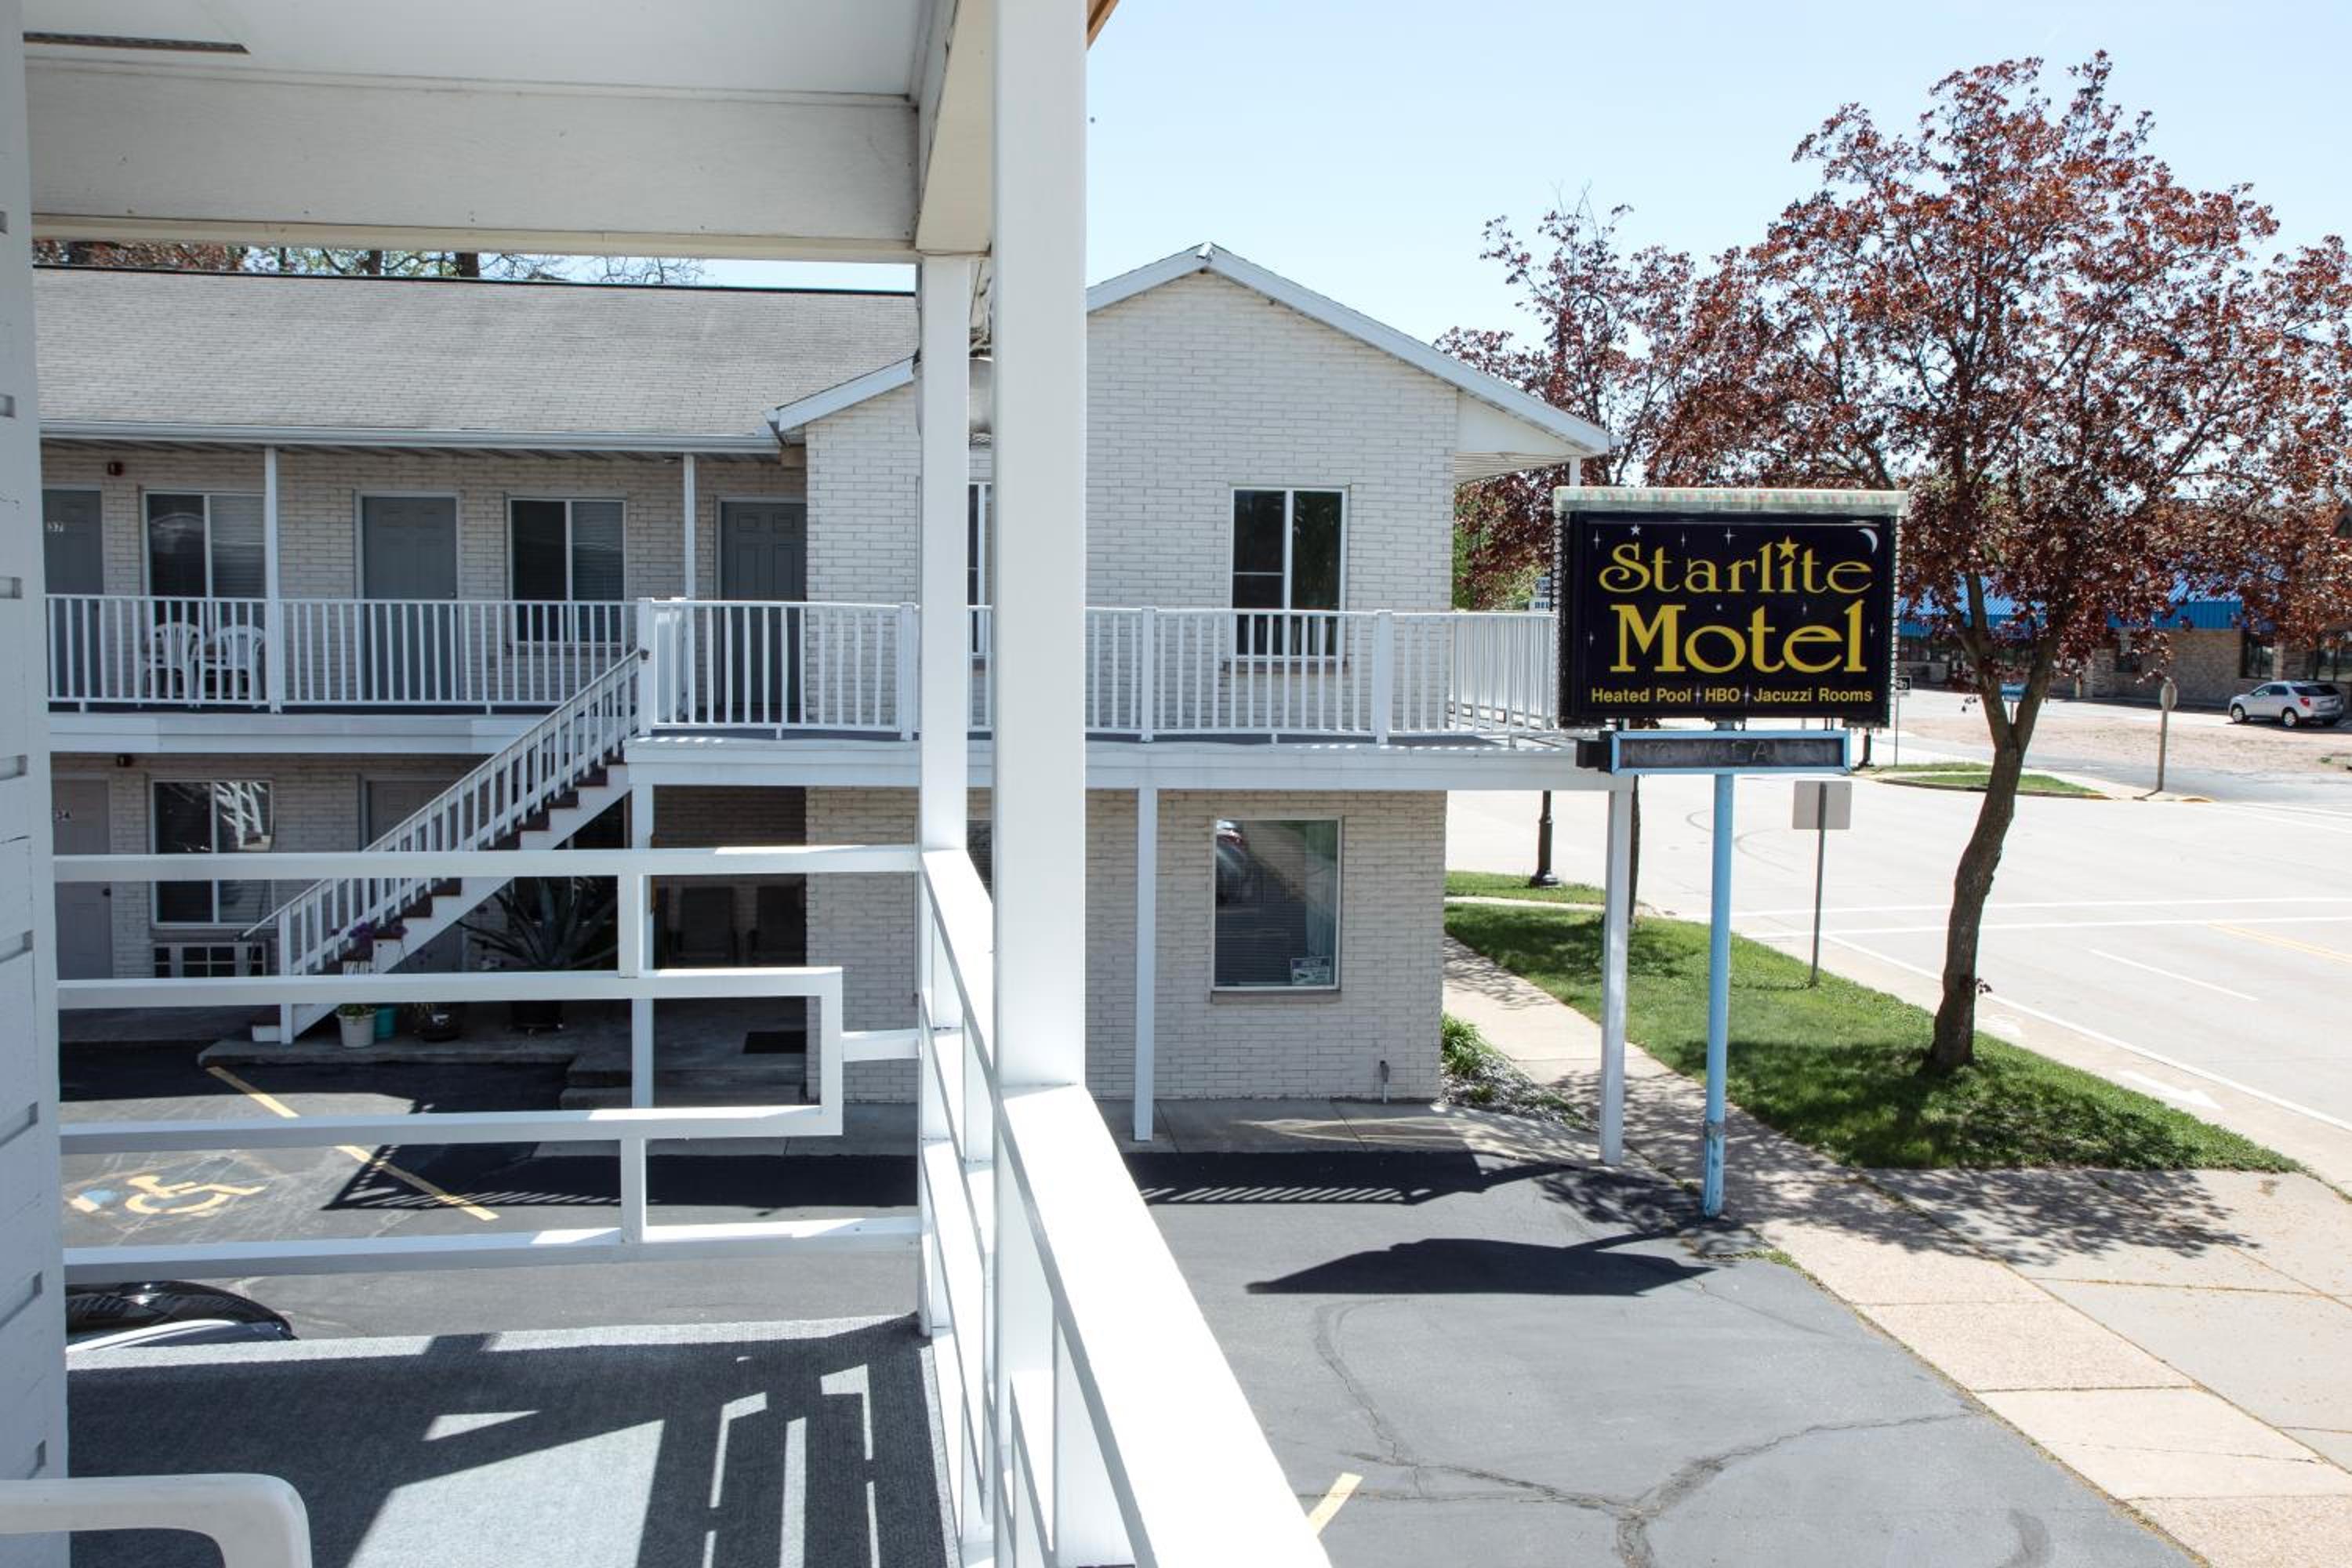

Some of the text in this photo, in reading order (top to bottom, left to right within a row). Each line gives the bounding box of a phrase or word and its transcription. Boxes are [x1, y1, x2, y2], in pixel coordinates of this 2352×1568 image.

[1599, 536, 1874, 593] Starlite
[1610, 599, 1868, 673] Motel
[1592, 688, 1873, 702] Heated Pool HBO Jacuzzi Rooms
